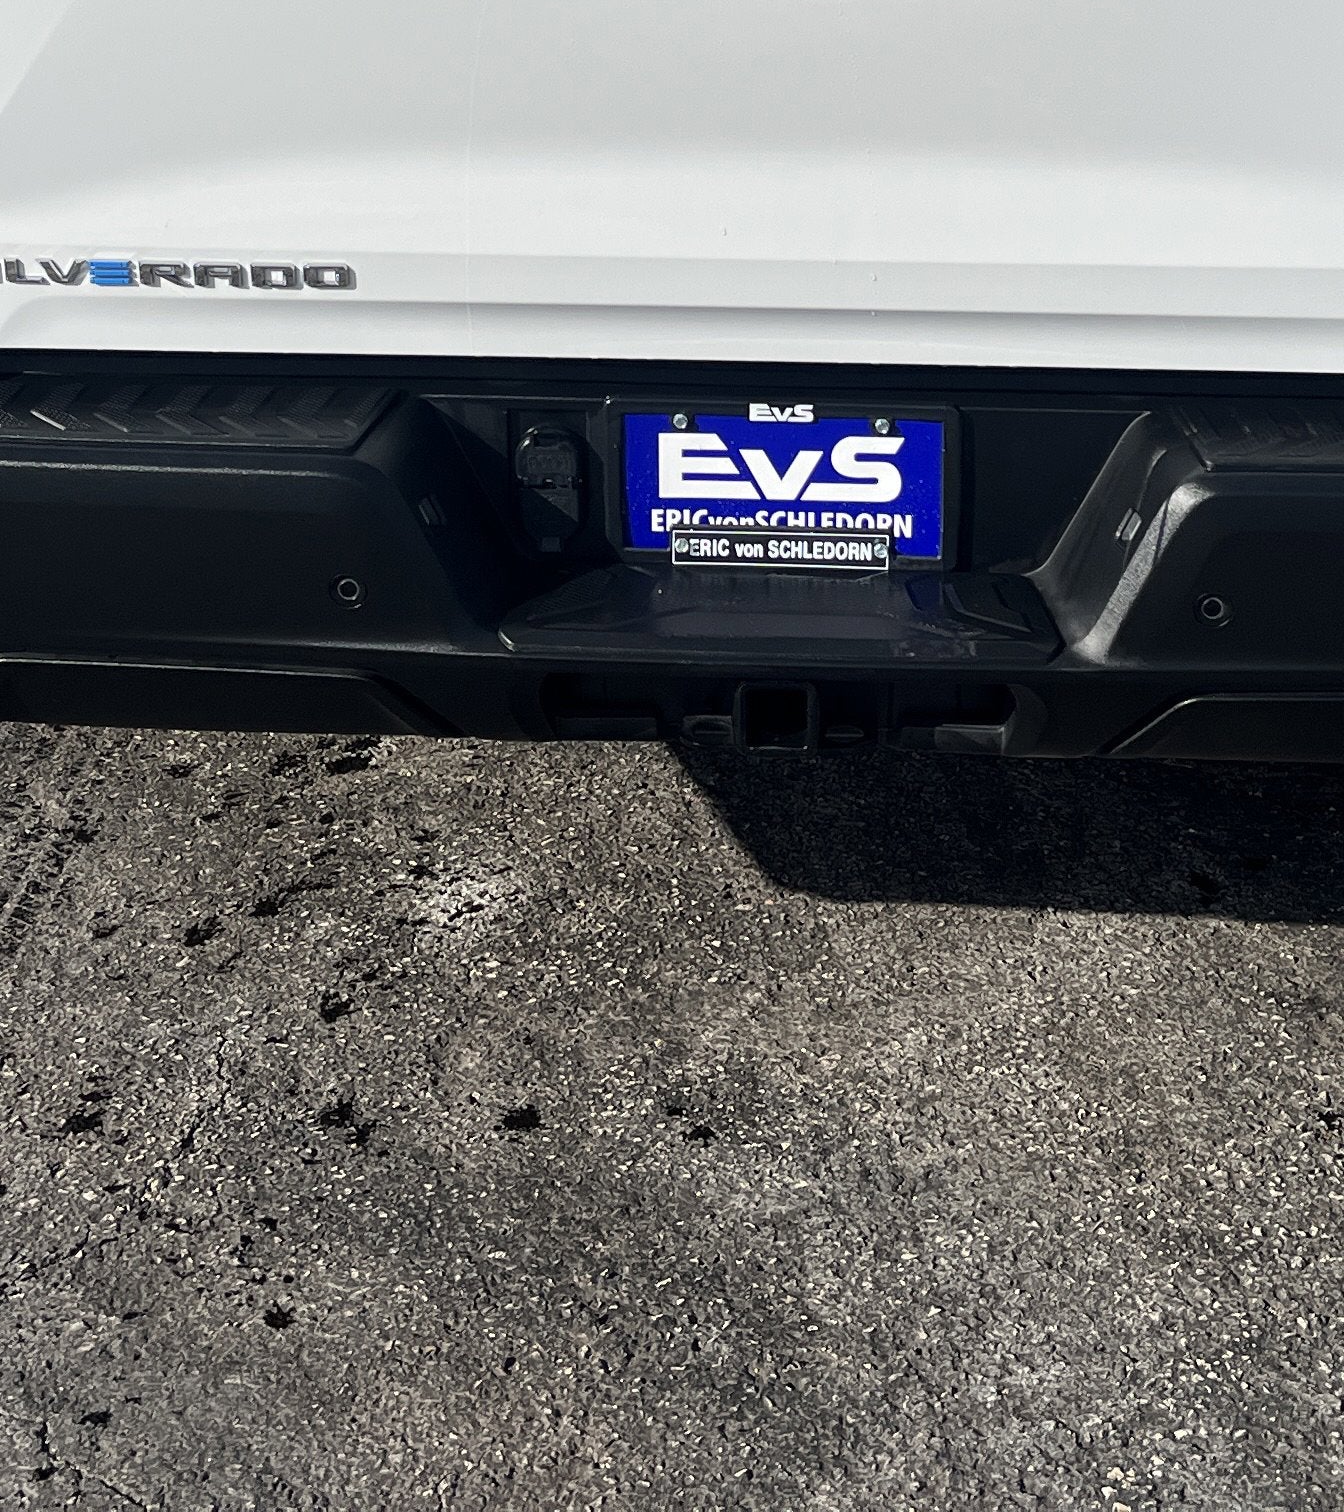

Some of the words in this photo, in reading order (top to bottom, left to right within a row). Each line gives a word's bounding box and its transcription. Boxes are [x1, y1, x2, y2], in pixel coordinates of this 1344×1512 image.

[689, 538, 730, 557] ERIC
[735, 543, 764, 558] von
[768, 539, 873, 561] SCHLEDORN
